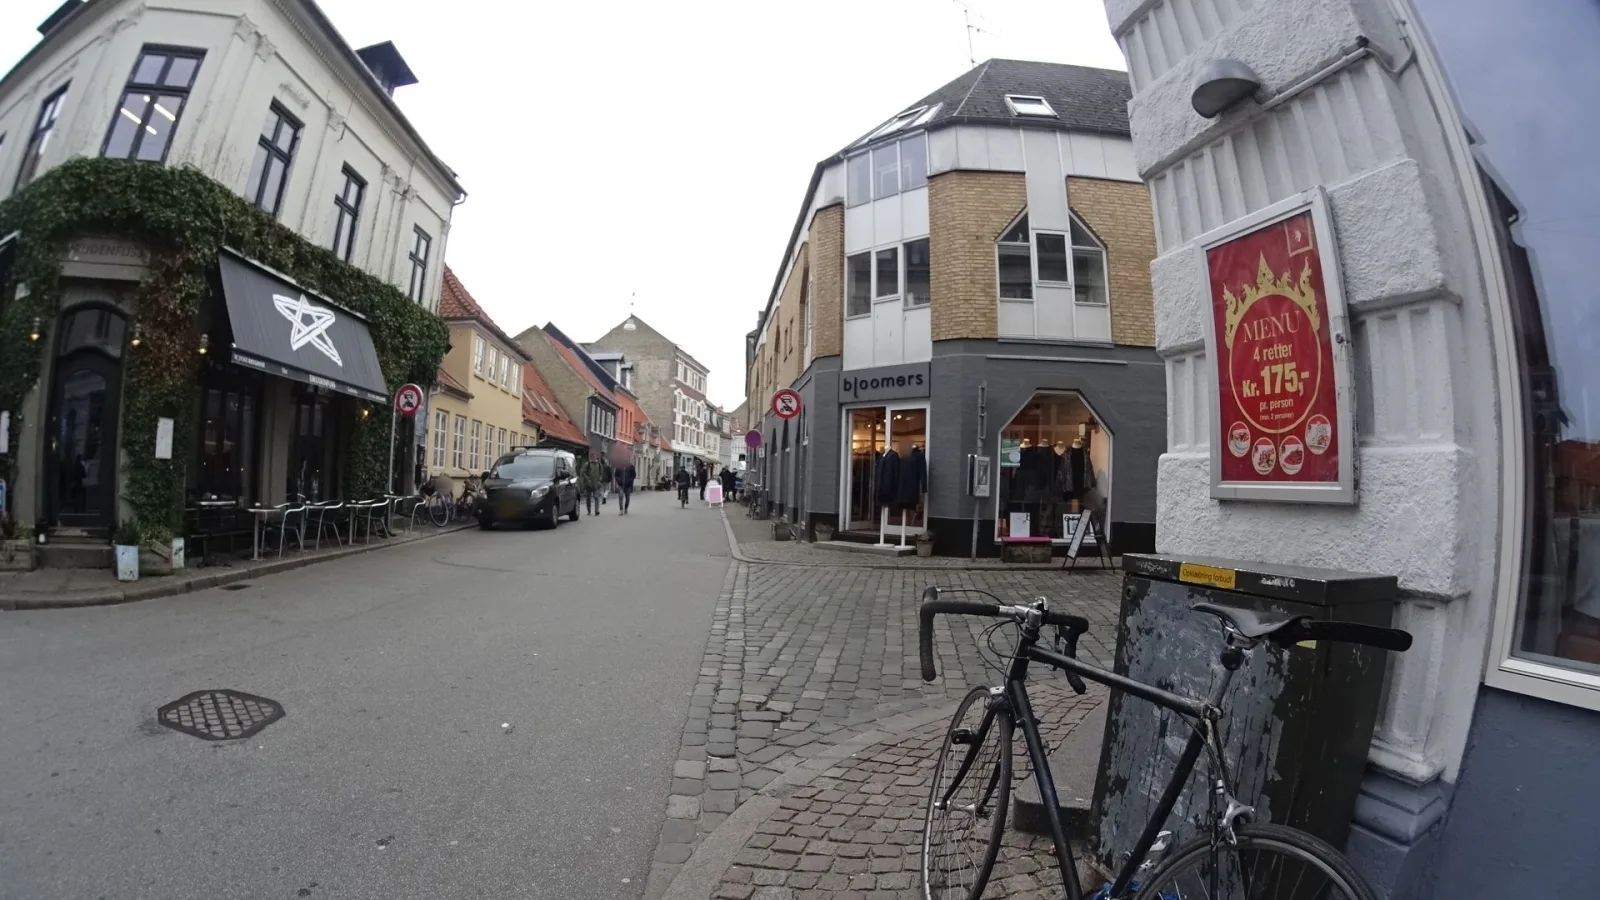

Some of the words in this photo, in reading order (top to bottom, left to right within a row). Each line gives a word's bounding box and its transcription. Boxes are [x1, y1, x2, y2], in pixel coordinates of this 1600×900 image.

[1243, 310, 1300, 343] MENU
[1253, 346, 1261, 362] 4
[1263, 343, 1292, 361] retter
[843, 374, 924, 398] bloomers
[1242, 379, 1260, 398] Kr.
[1260, 361, 1310, 397] 175,-
[1259, 401, 1269, 412] pr.
[1269, 398, 1294, 411] person
[1213, 573, 1233, 584] forbudt
